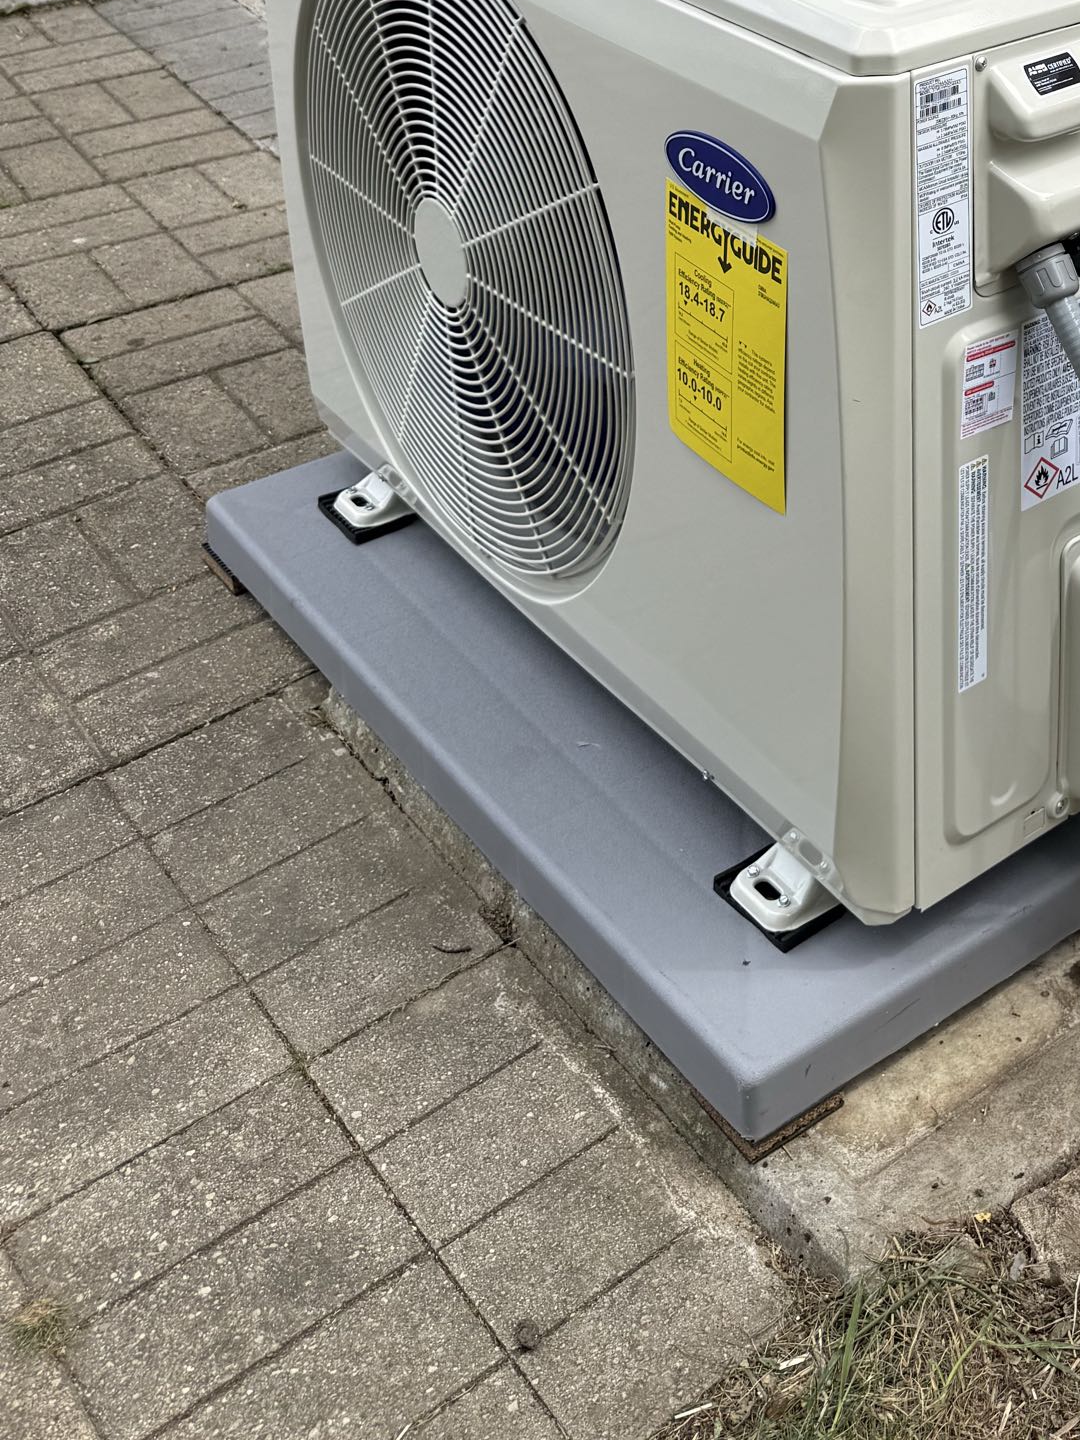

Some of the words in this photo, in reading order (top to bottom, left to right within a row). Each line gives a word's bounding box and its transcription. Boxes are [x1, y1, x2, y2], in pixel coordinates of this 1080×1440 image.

[678, 147, 755, 205] Carrier
[678, 267, 699, 291] Efficiency
[700, 282, 715, 301] Rating
[694, 268, 712, 289] Cooling
[679, 279, 725, 325] 18.4-18.7
[678, 355, 699, 380] Efficiency
[699, 371, 714, 391] Rating
[693, 357, 710, 379] Heating
[677, 366, 721, 412] 10.0-10.0
[1056, 464, 1079, 489] A2L
